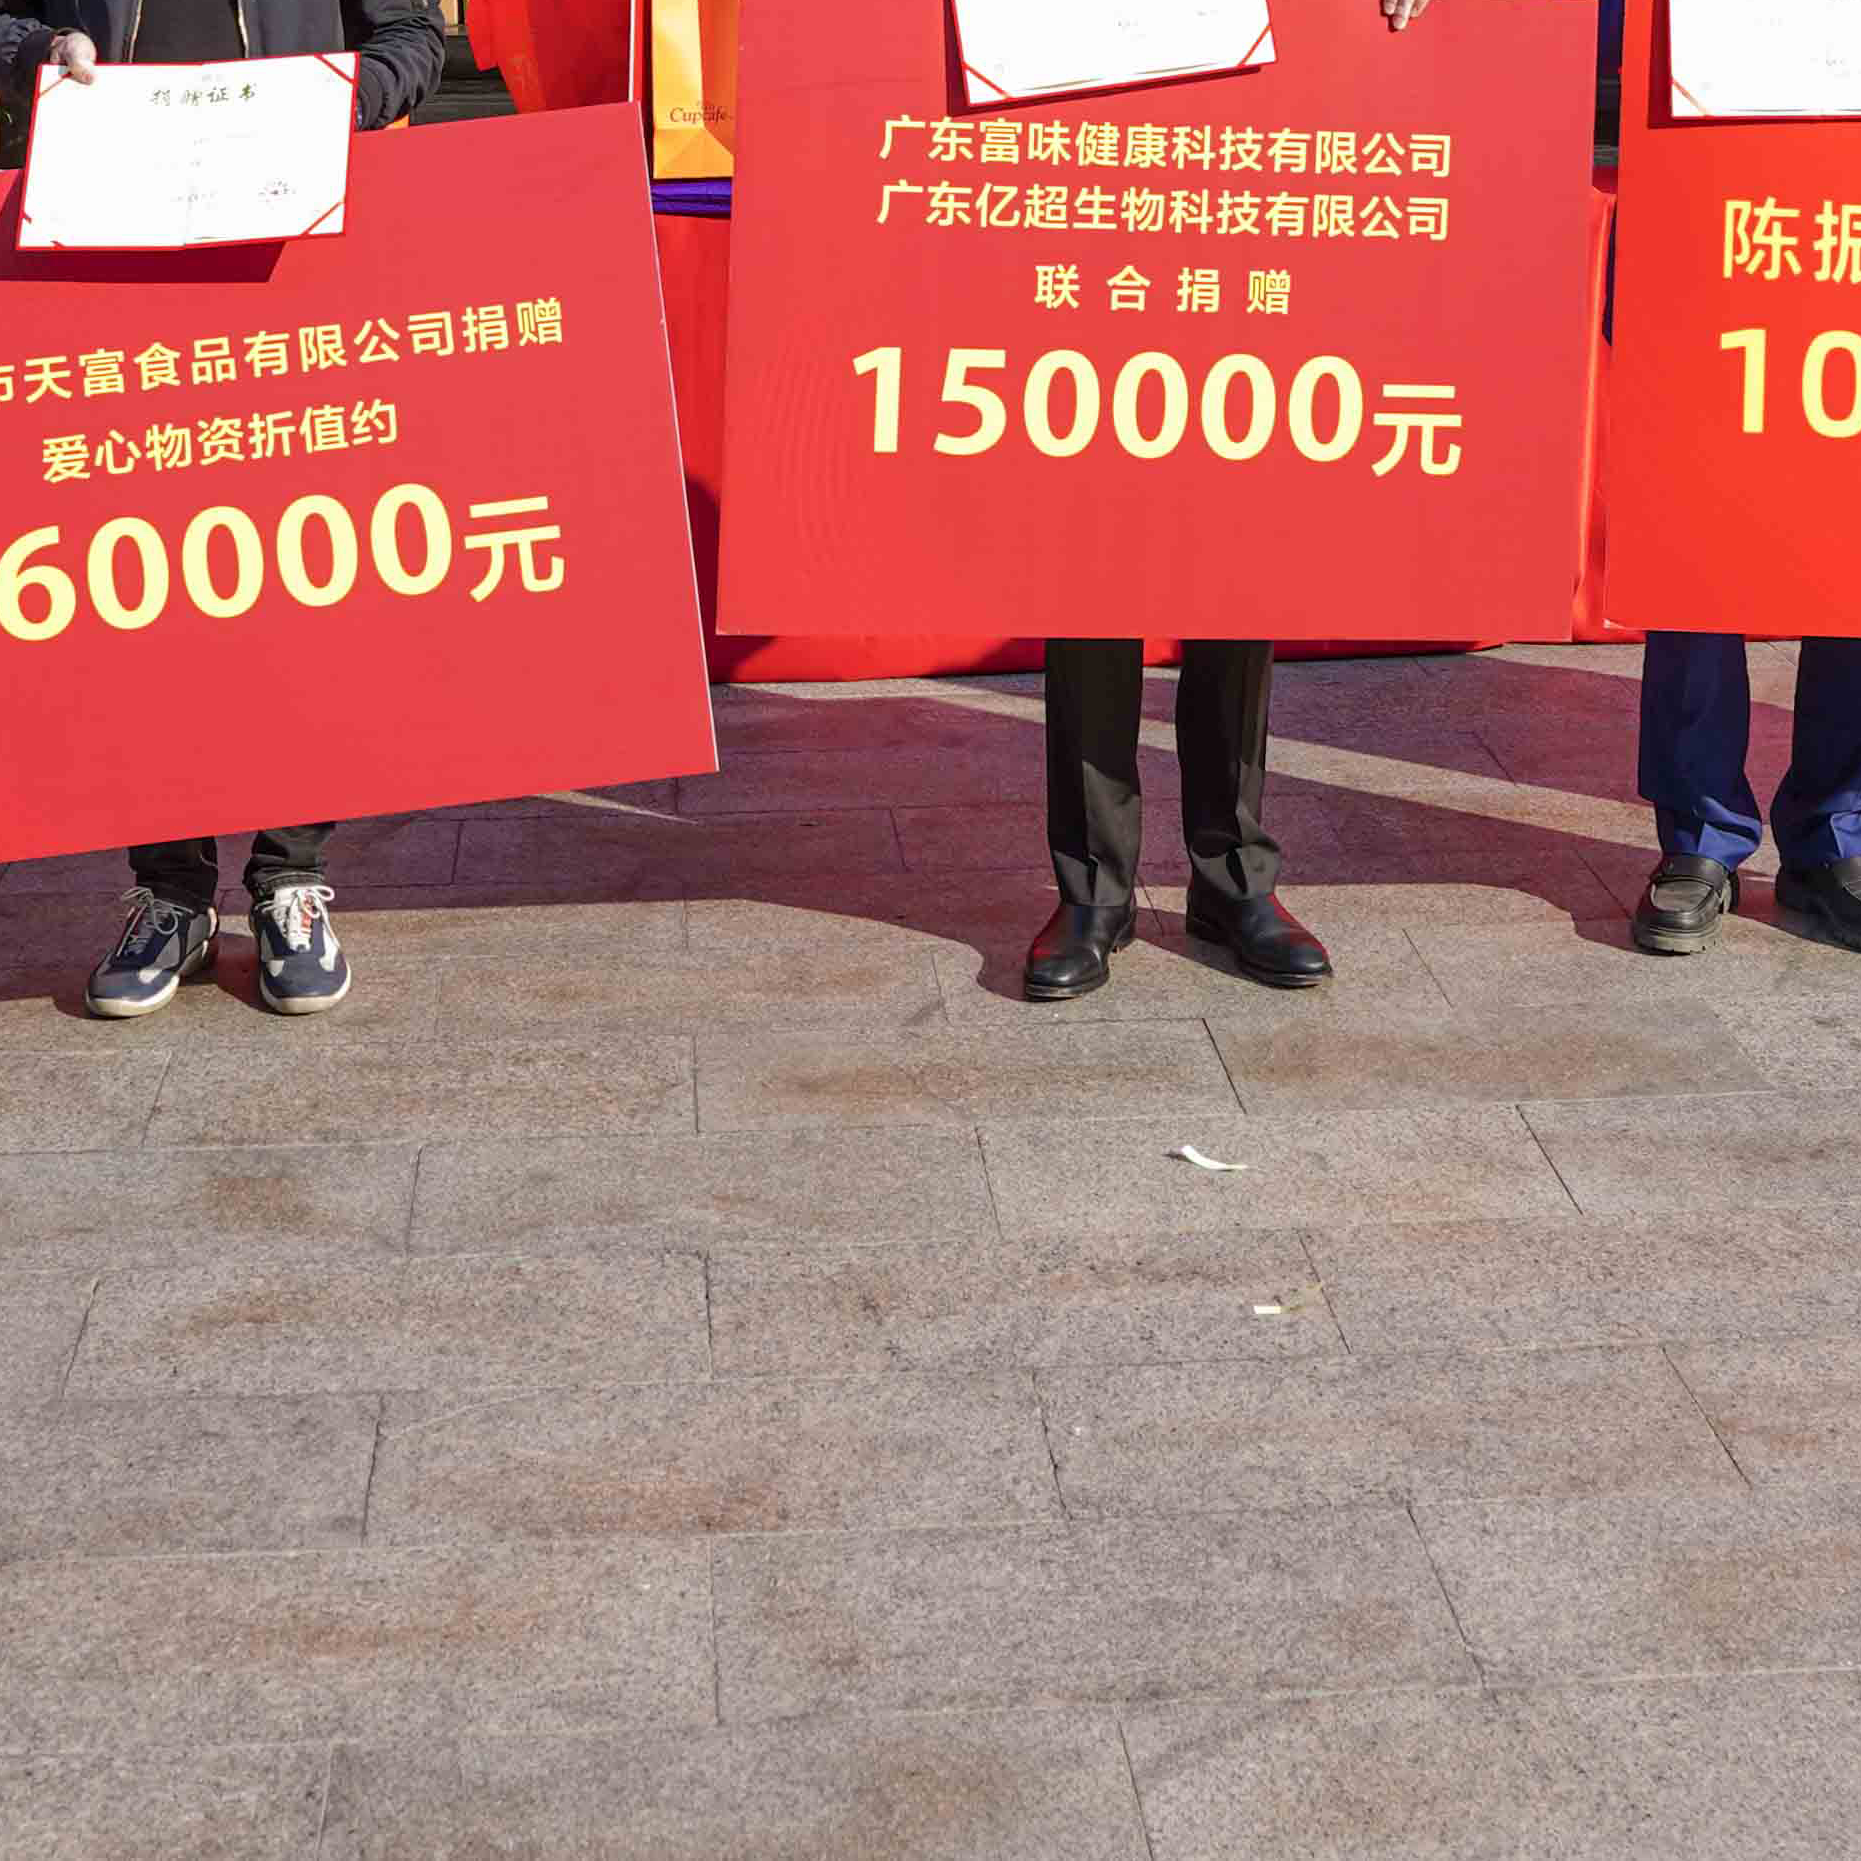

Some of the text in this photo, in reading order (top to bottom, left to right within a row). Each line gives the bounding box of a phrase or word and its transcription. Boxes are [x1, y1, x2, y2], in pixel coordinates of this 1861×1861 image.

[879, 115, 1451, 178] 广东富味健康科技有限公司
[877, 179, 1449, 241] 广东亿超生物科技有限公司
[42, 398, 398, 483] 爱心物资折值约
[852, 346, 1463, 477] 150000元
